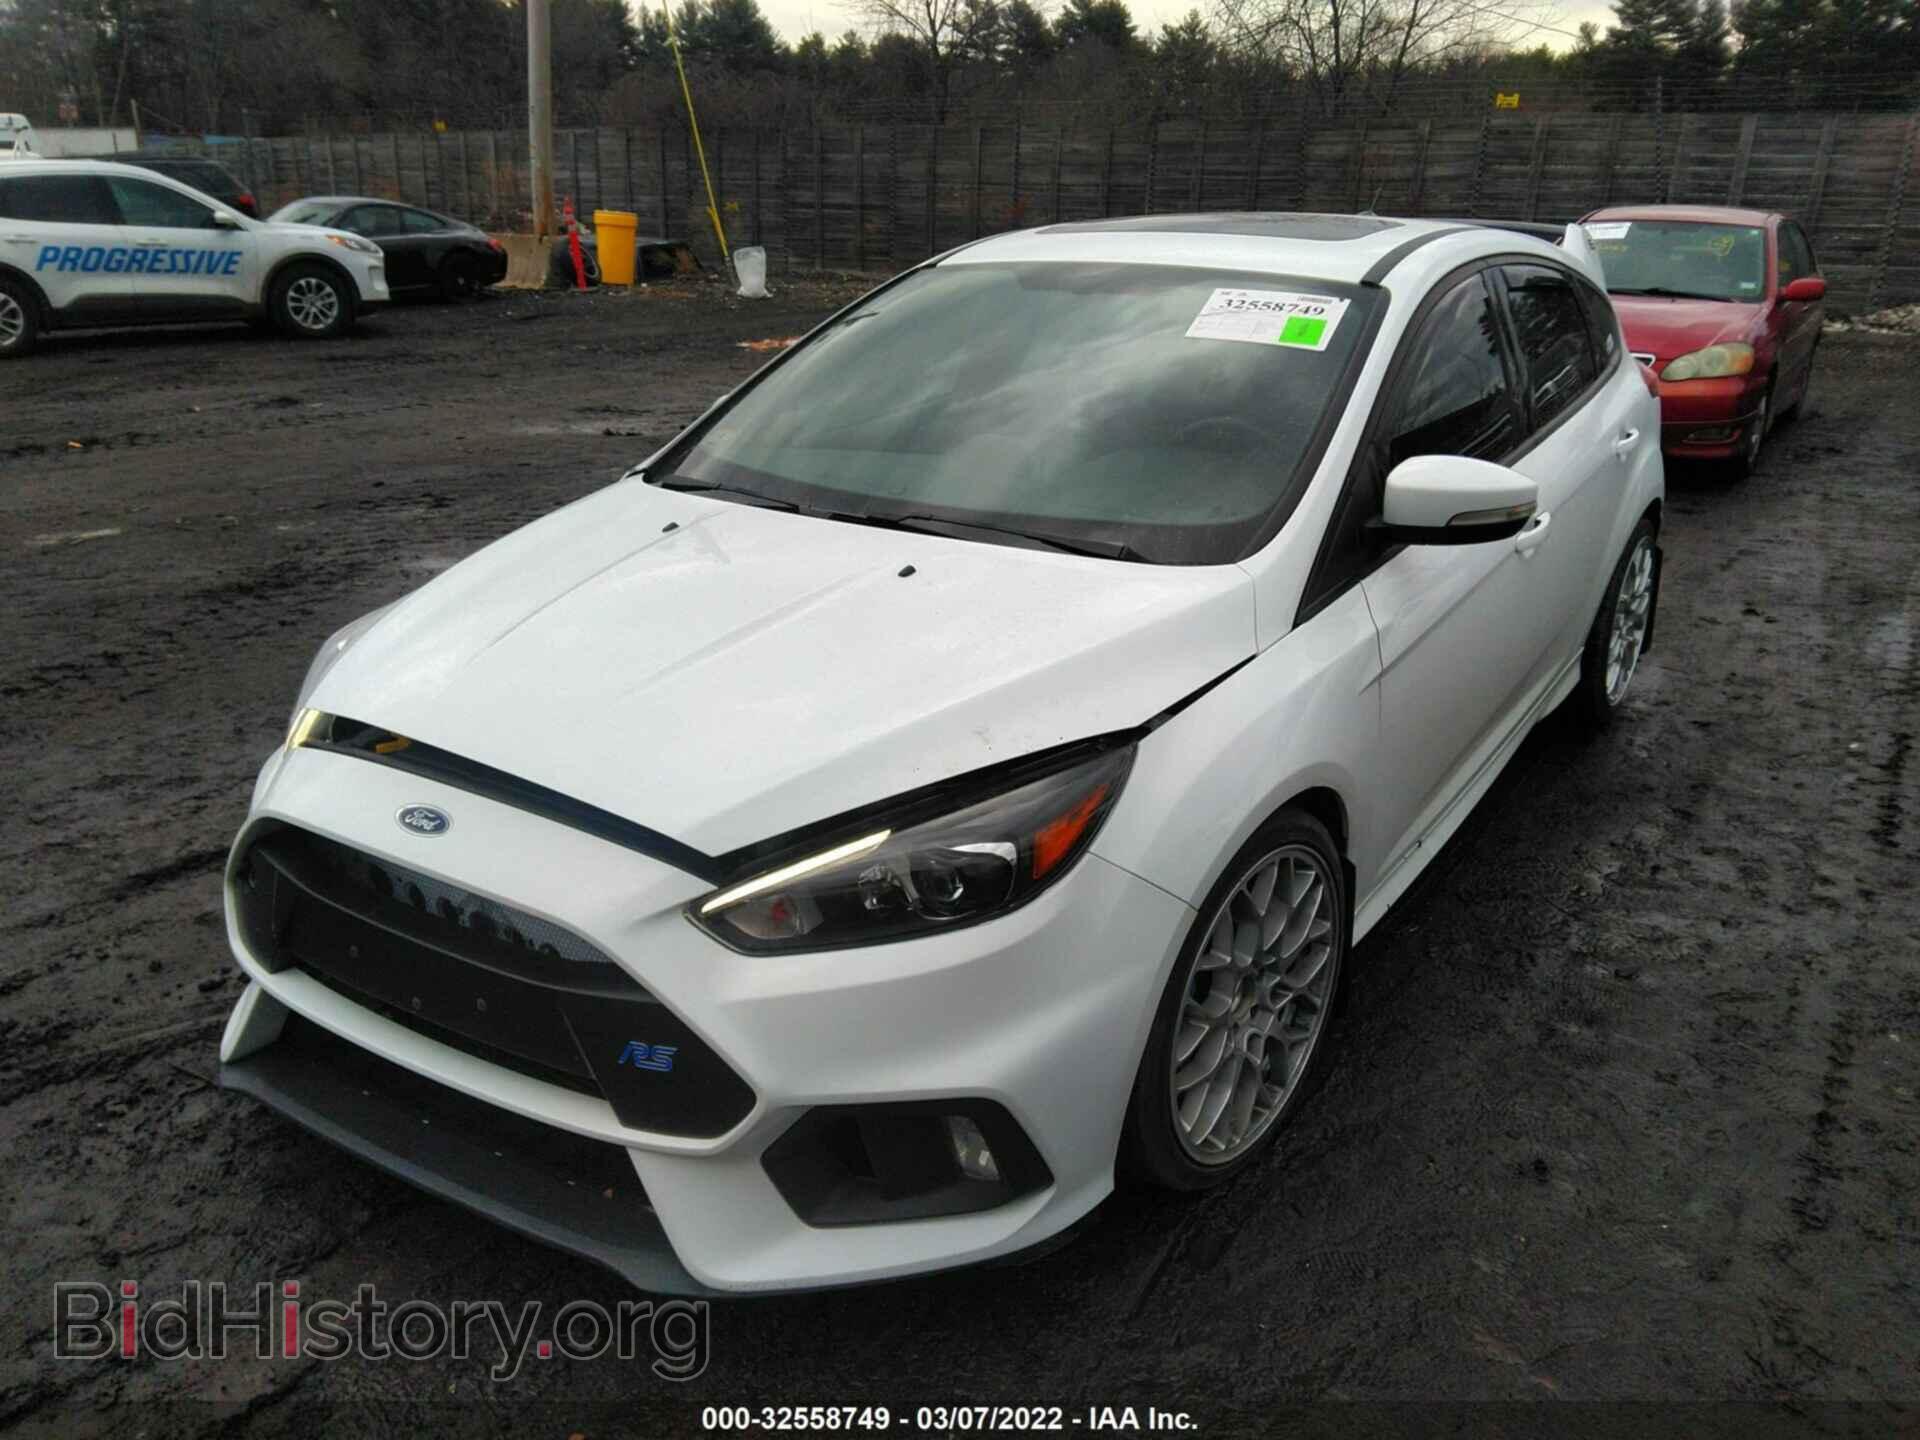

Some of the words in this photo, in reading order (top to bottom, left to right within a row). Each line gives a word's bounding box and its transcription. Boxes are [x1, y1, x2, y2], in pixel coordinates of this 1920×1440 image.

[36, 245, 243, 275] PROGRESSIVE
[1219, 298, 1326, 316] 32558749
[403, 808, 442, 833] Ford
[618, 1041, 680, 1072] RS
